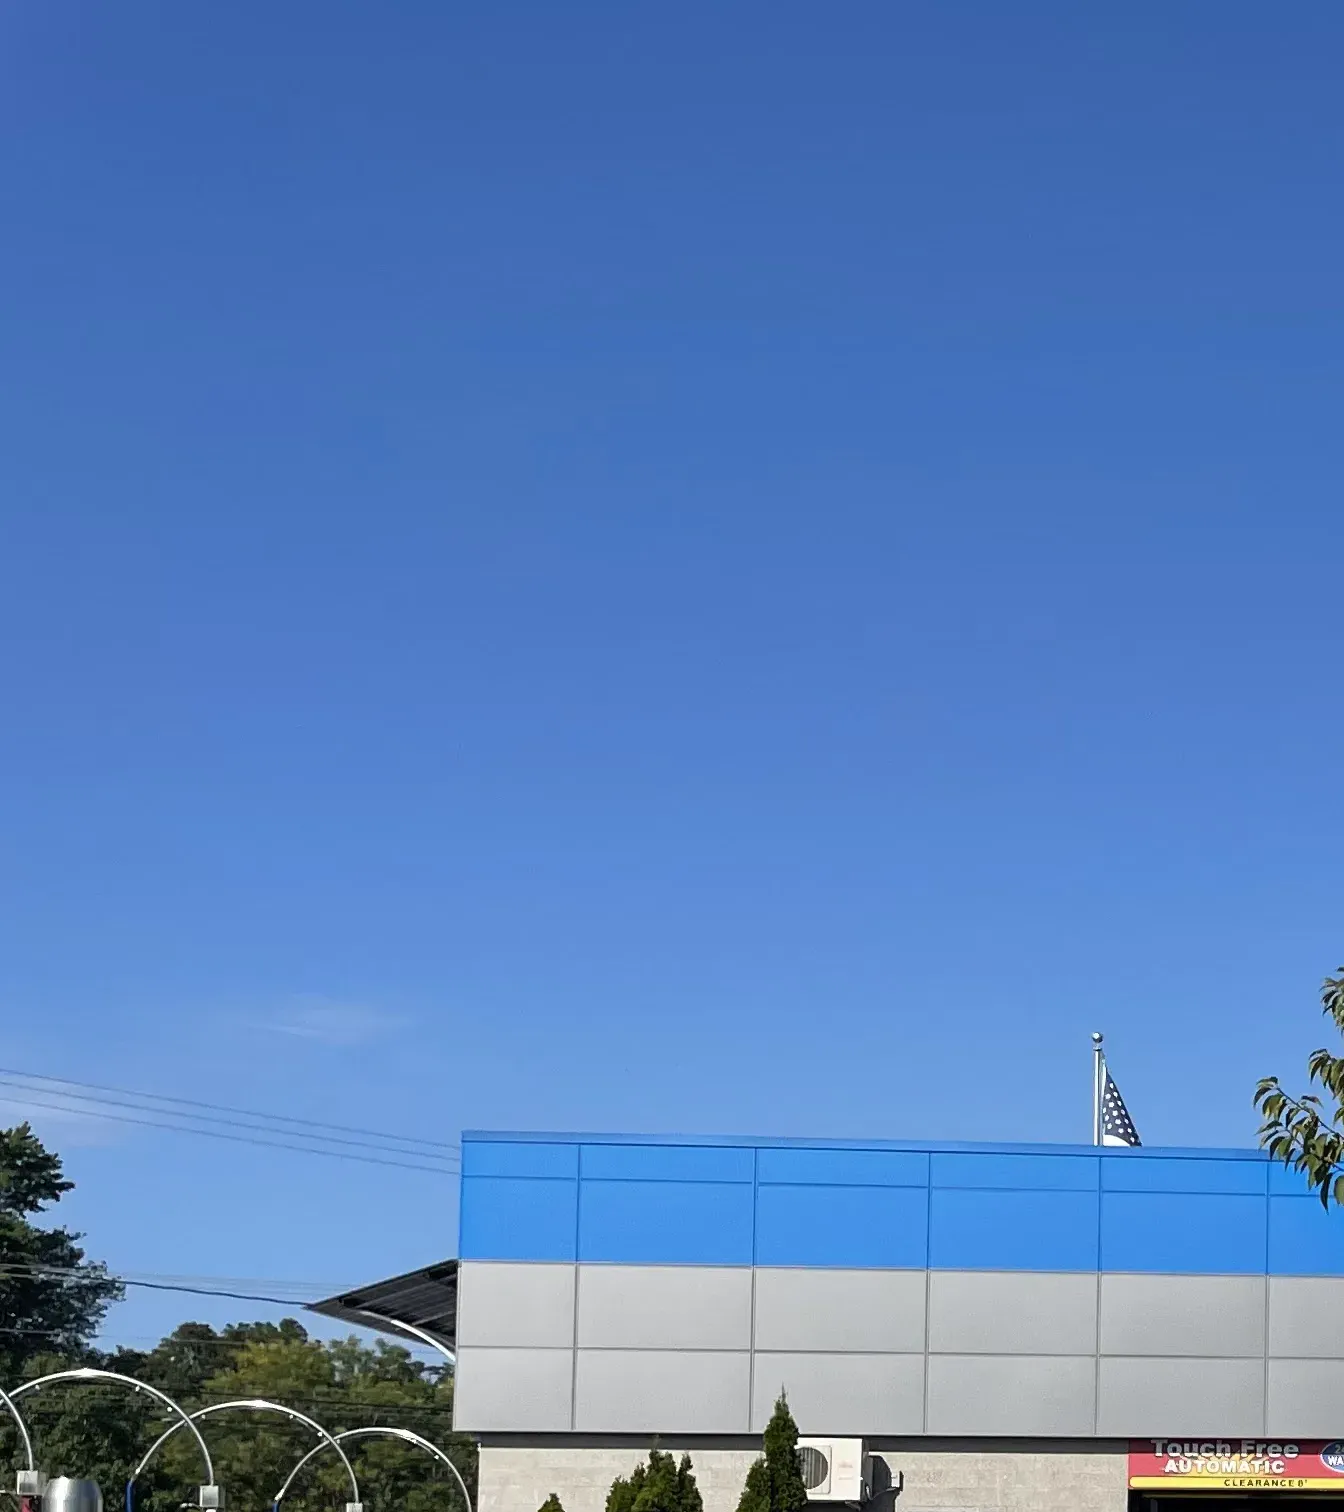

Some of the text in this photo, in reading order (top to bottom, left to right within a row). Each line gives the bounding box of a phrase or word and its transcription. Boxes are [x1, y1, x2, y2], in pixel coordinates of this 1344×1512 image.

[1150, 1439, 1300, 1458] Touch Free
[1164, 1459, 1286, 1474] AUTOMATIC
[1224, 1479, 1295, 1488] CLEARANCE
